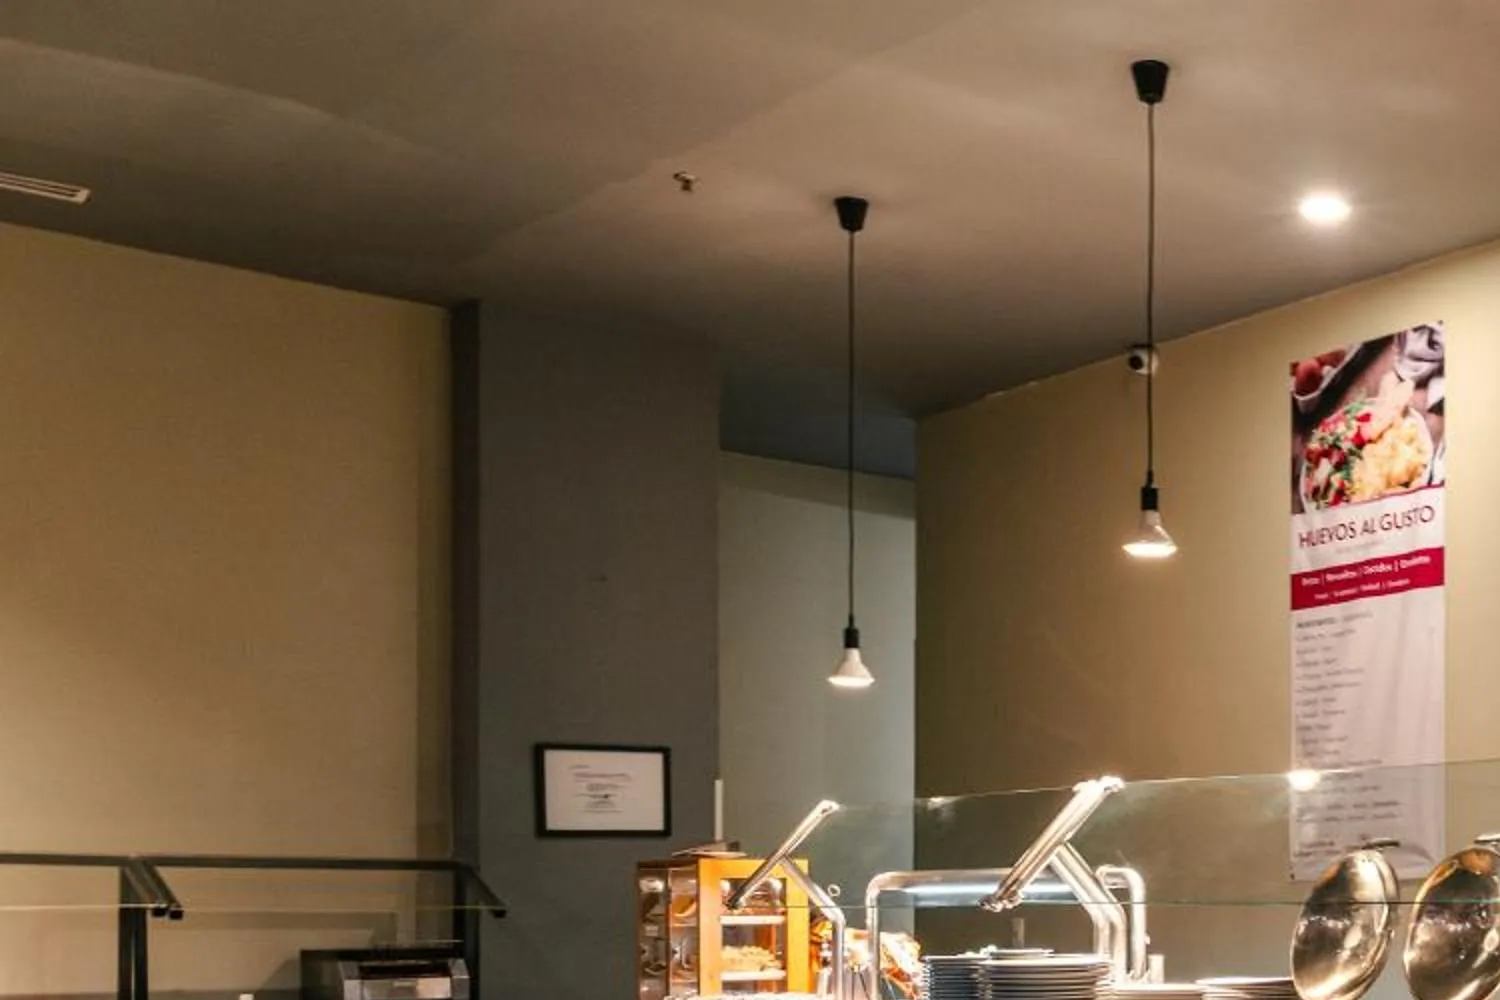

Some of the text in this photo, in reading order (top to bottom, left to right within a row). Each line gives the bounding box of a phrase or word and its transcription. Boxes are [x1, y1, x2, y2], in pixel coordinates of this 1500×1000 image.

[1298, 521, 1357, 548] HUEVOS
[1360, 517, 1377, 536] AL
[1379, 505, 1436, 531] GUSTO
